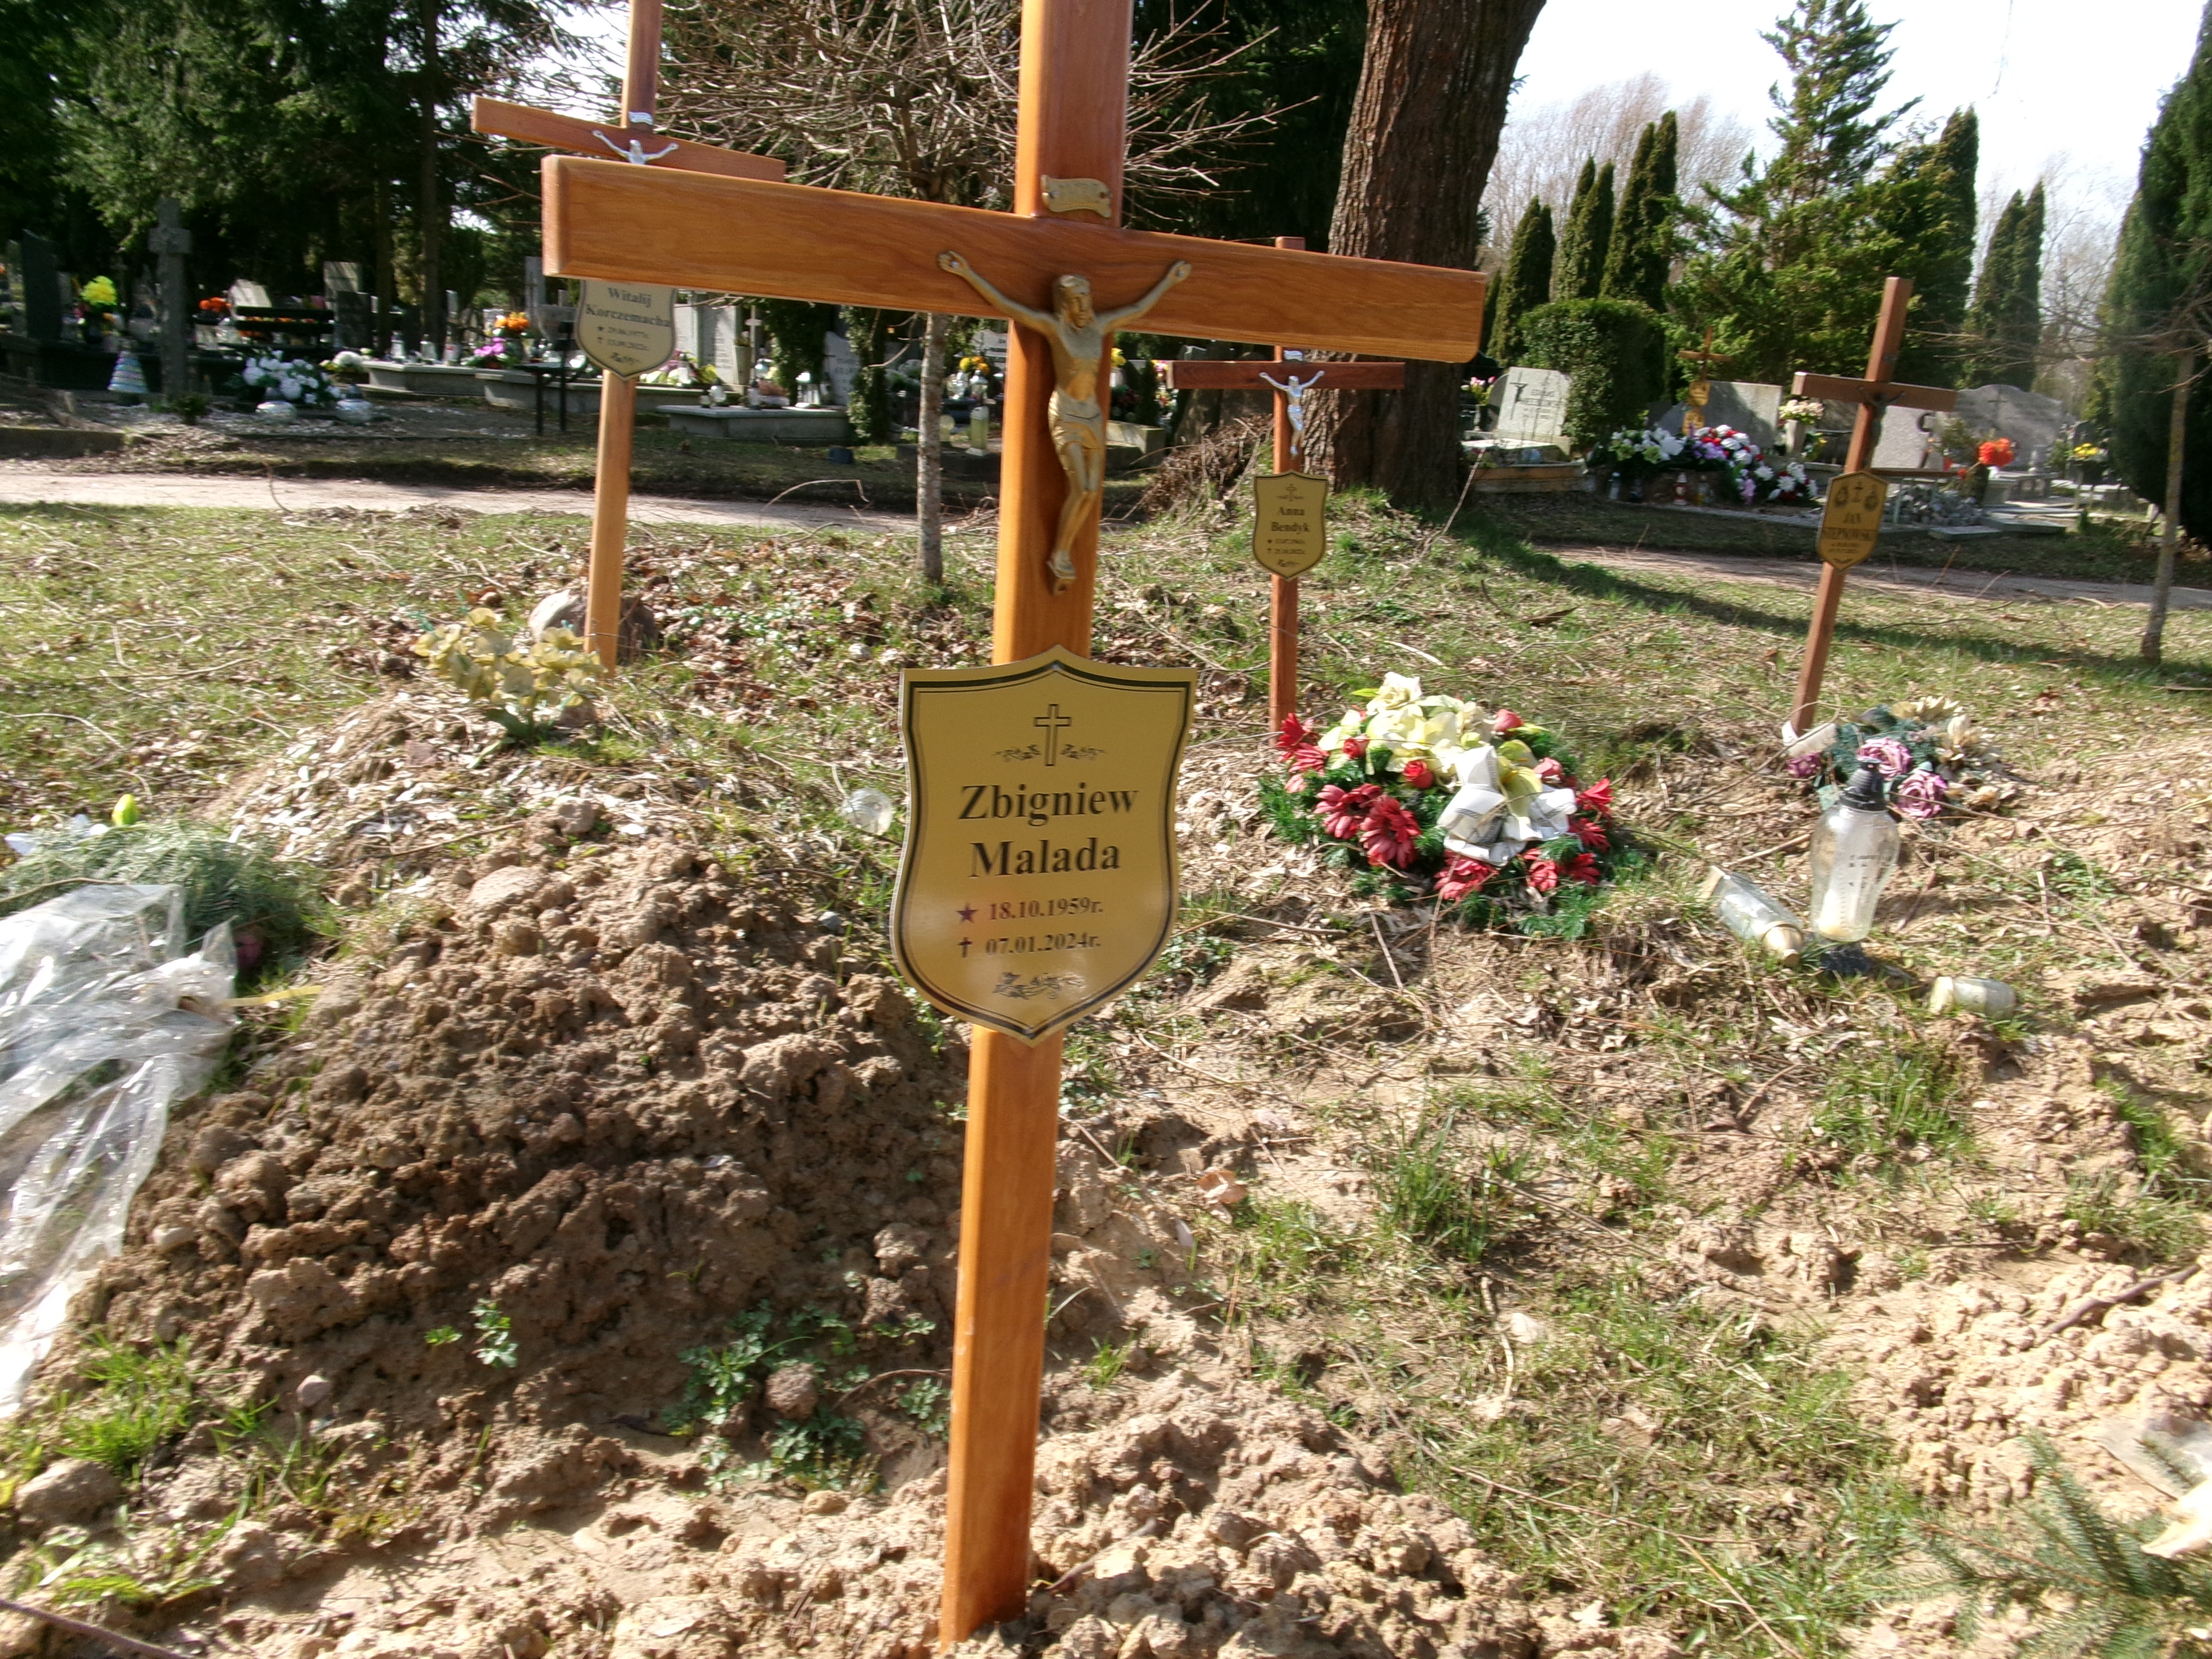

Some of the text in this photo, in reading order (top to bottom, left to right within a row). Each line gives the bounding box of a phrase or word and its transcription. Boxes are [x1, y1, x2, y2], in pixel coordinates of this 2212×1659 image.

[607, 288, 651, 308] Witalij
[1277, 507, 1305, 516] Anna
[1271, 522, 1310, 534] Bendyk
[958, 782, 1140, 827] Zbigniew
[968, 836, 1121, 878] Malada
[989, 897, 1103, 920] 18.10.1959r.
[986, 932, 1101, 956] 07.01.2024r.
